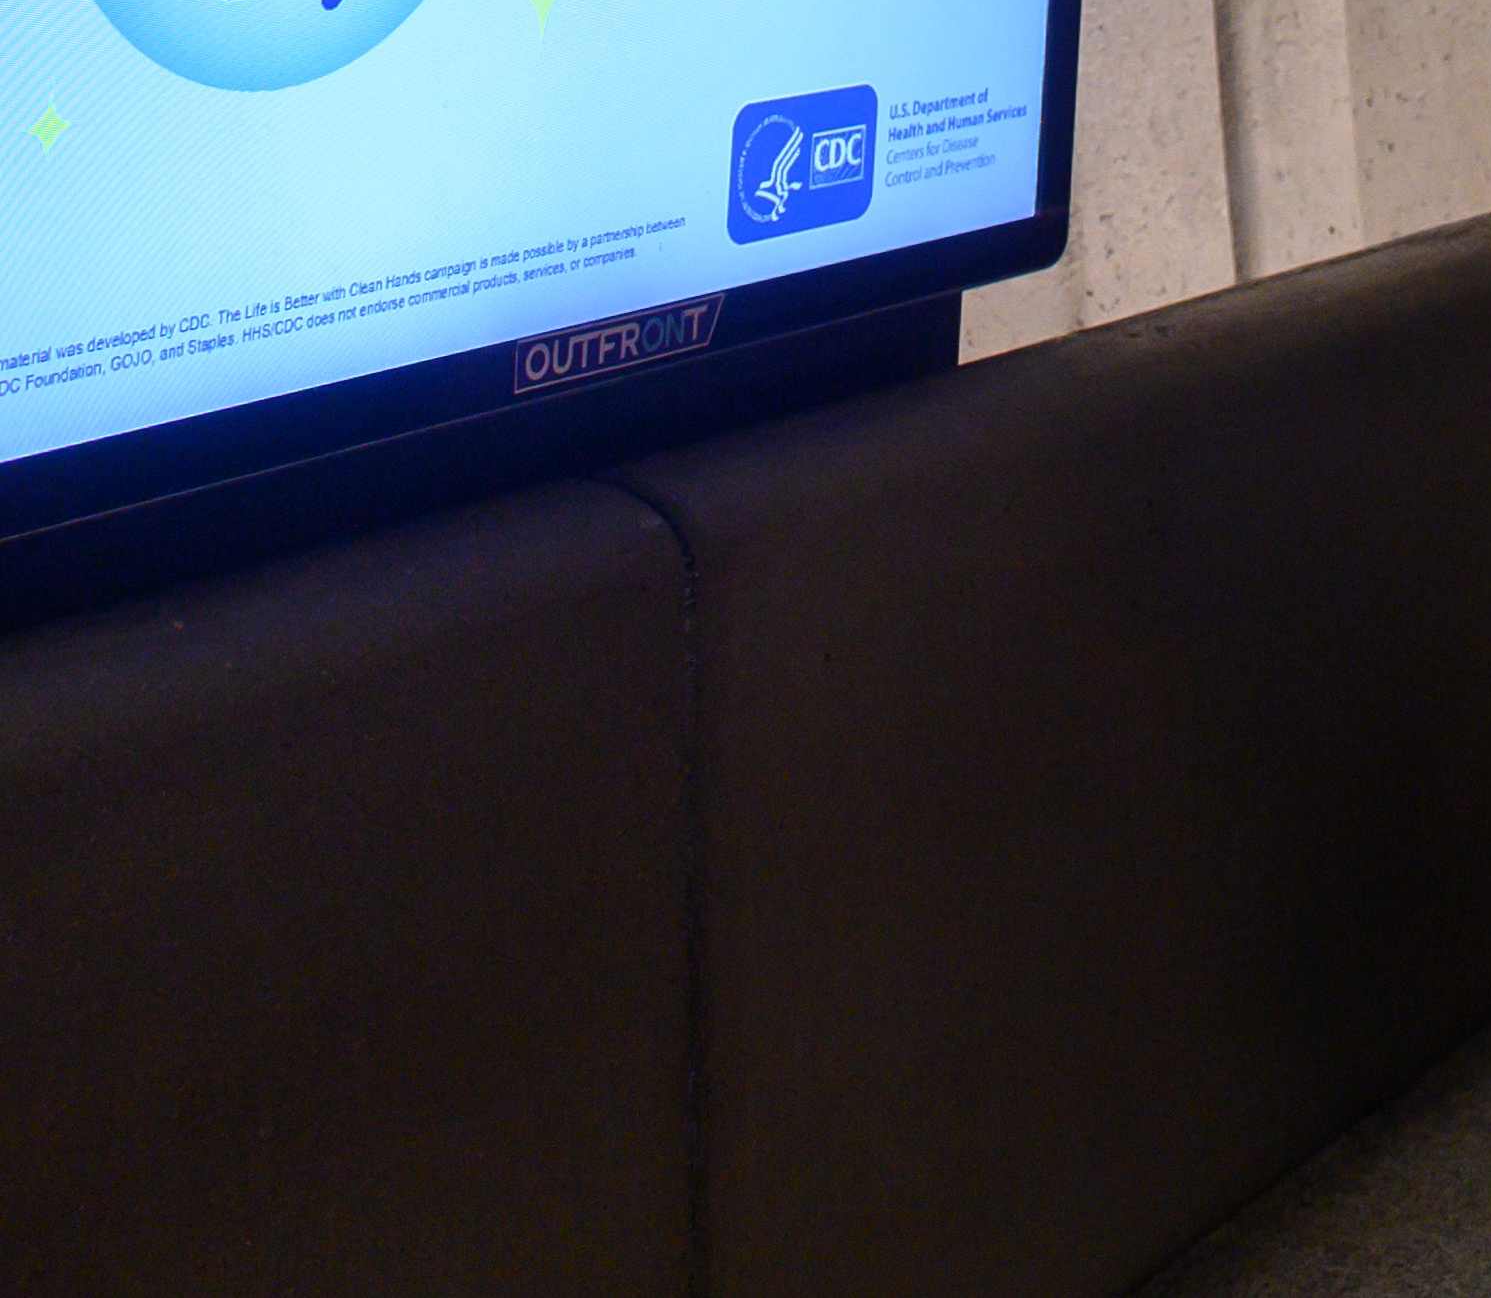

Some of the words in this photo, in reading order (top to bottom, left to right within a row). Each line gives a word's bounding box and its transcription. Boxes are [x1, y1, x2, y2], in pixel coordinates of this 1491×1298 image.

[890, 104, 910, 120] U.S.
[913, 93, 976, 115] Department
[977, 88, 989, 104] of
[888, 121, 923, 142] Health
[926, 118, 946, 135] and
[948, 114, 984, 131] Human
[986, 105, 1027, 123] Services
[814, 133, 862, 173] CDC
[926, 140, 940, 156] for
[924, 160, 944, 179] and
[56, 342, 84, 359] was
[87, 324, 157, 352] developed
[160, 322, 176, 339] by
[218, 309, 241, 324] The
[245, 303, 267, 319] Life
[270, 300, 280, 314] is
[284, 293, 320, 311] Better
[322, 285, 346, 302] with
[349, 279, 383, 297] Clean
[385, 271, 421, 289] Hands
[424, 260, 476, 280] campaign
[479, 257, 488, 270] is
[491, 250, 520, 267] made
[523, 240, 565, 263] possible
[567, 238, 580, 253] by
[581, 237, 588, 249] a
[590, 224, 645, 249] partnership
[646, 216, 687, 235] between
[25, 363, 106, 391] Foundation,
[160, 342, 184, 360] and
[242, 316, 304, 342] HHS/CDC
[306, 312, 335, 329] does
[338, 306, 357, 322] not
[359, 297, 405, 317] endorse
[408, 281, 470, 306] commercial
[570, 258, 581, 271] or
[525, 304, 708, 381] OUTFRONT
